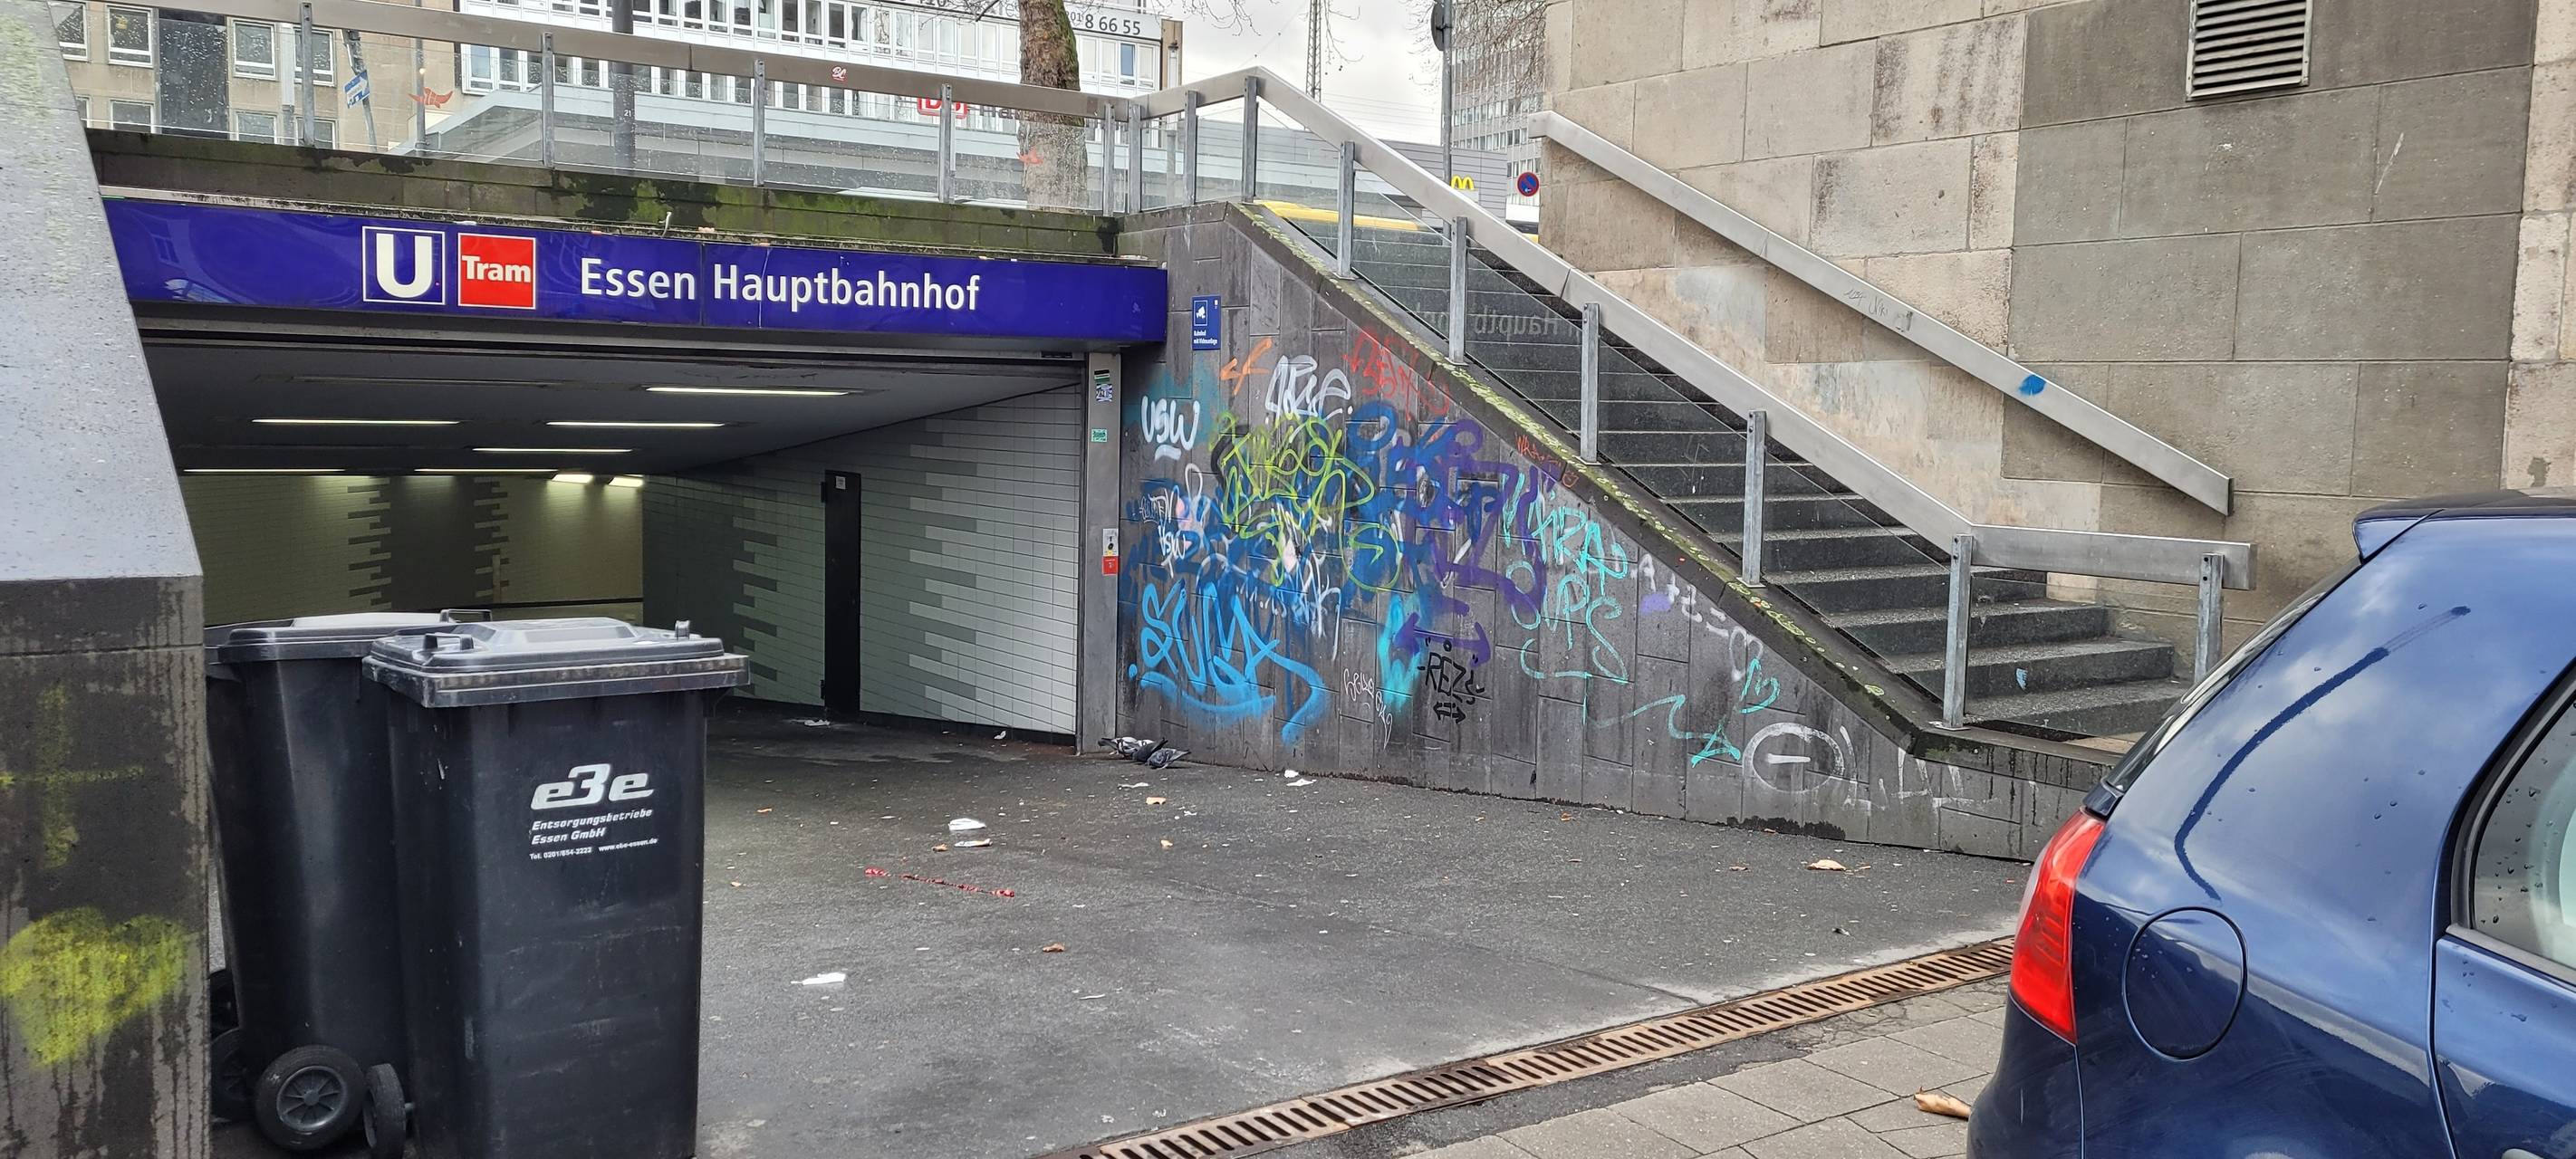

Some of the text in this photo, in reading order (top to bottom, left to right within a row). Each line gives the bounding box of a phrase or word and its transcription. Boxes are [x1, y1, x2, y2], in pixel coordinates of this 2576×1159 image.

[1085, 14, 1094, 29] 8
[1099, 16, 1118, 33] 66
[1123, 20, 1141, 35] 55
[624, 109, 631, 117] 21
[375, 233, 432, 299] U
[461, 254, 531, 283] Tram
[581, 257, 981, 312] Essen Hauptbahnhof
[532, 809, 653, 831] Entsorgungsbetriebe
[531, 827, 607, 845] Essen GmbH
[529, 852, 543, 860] Tel.
